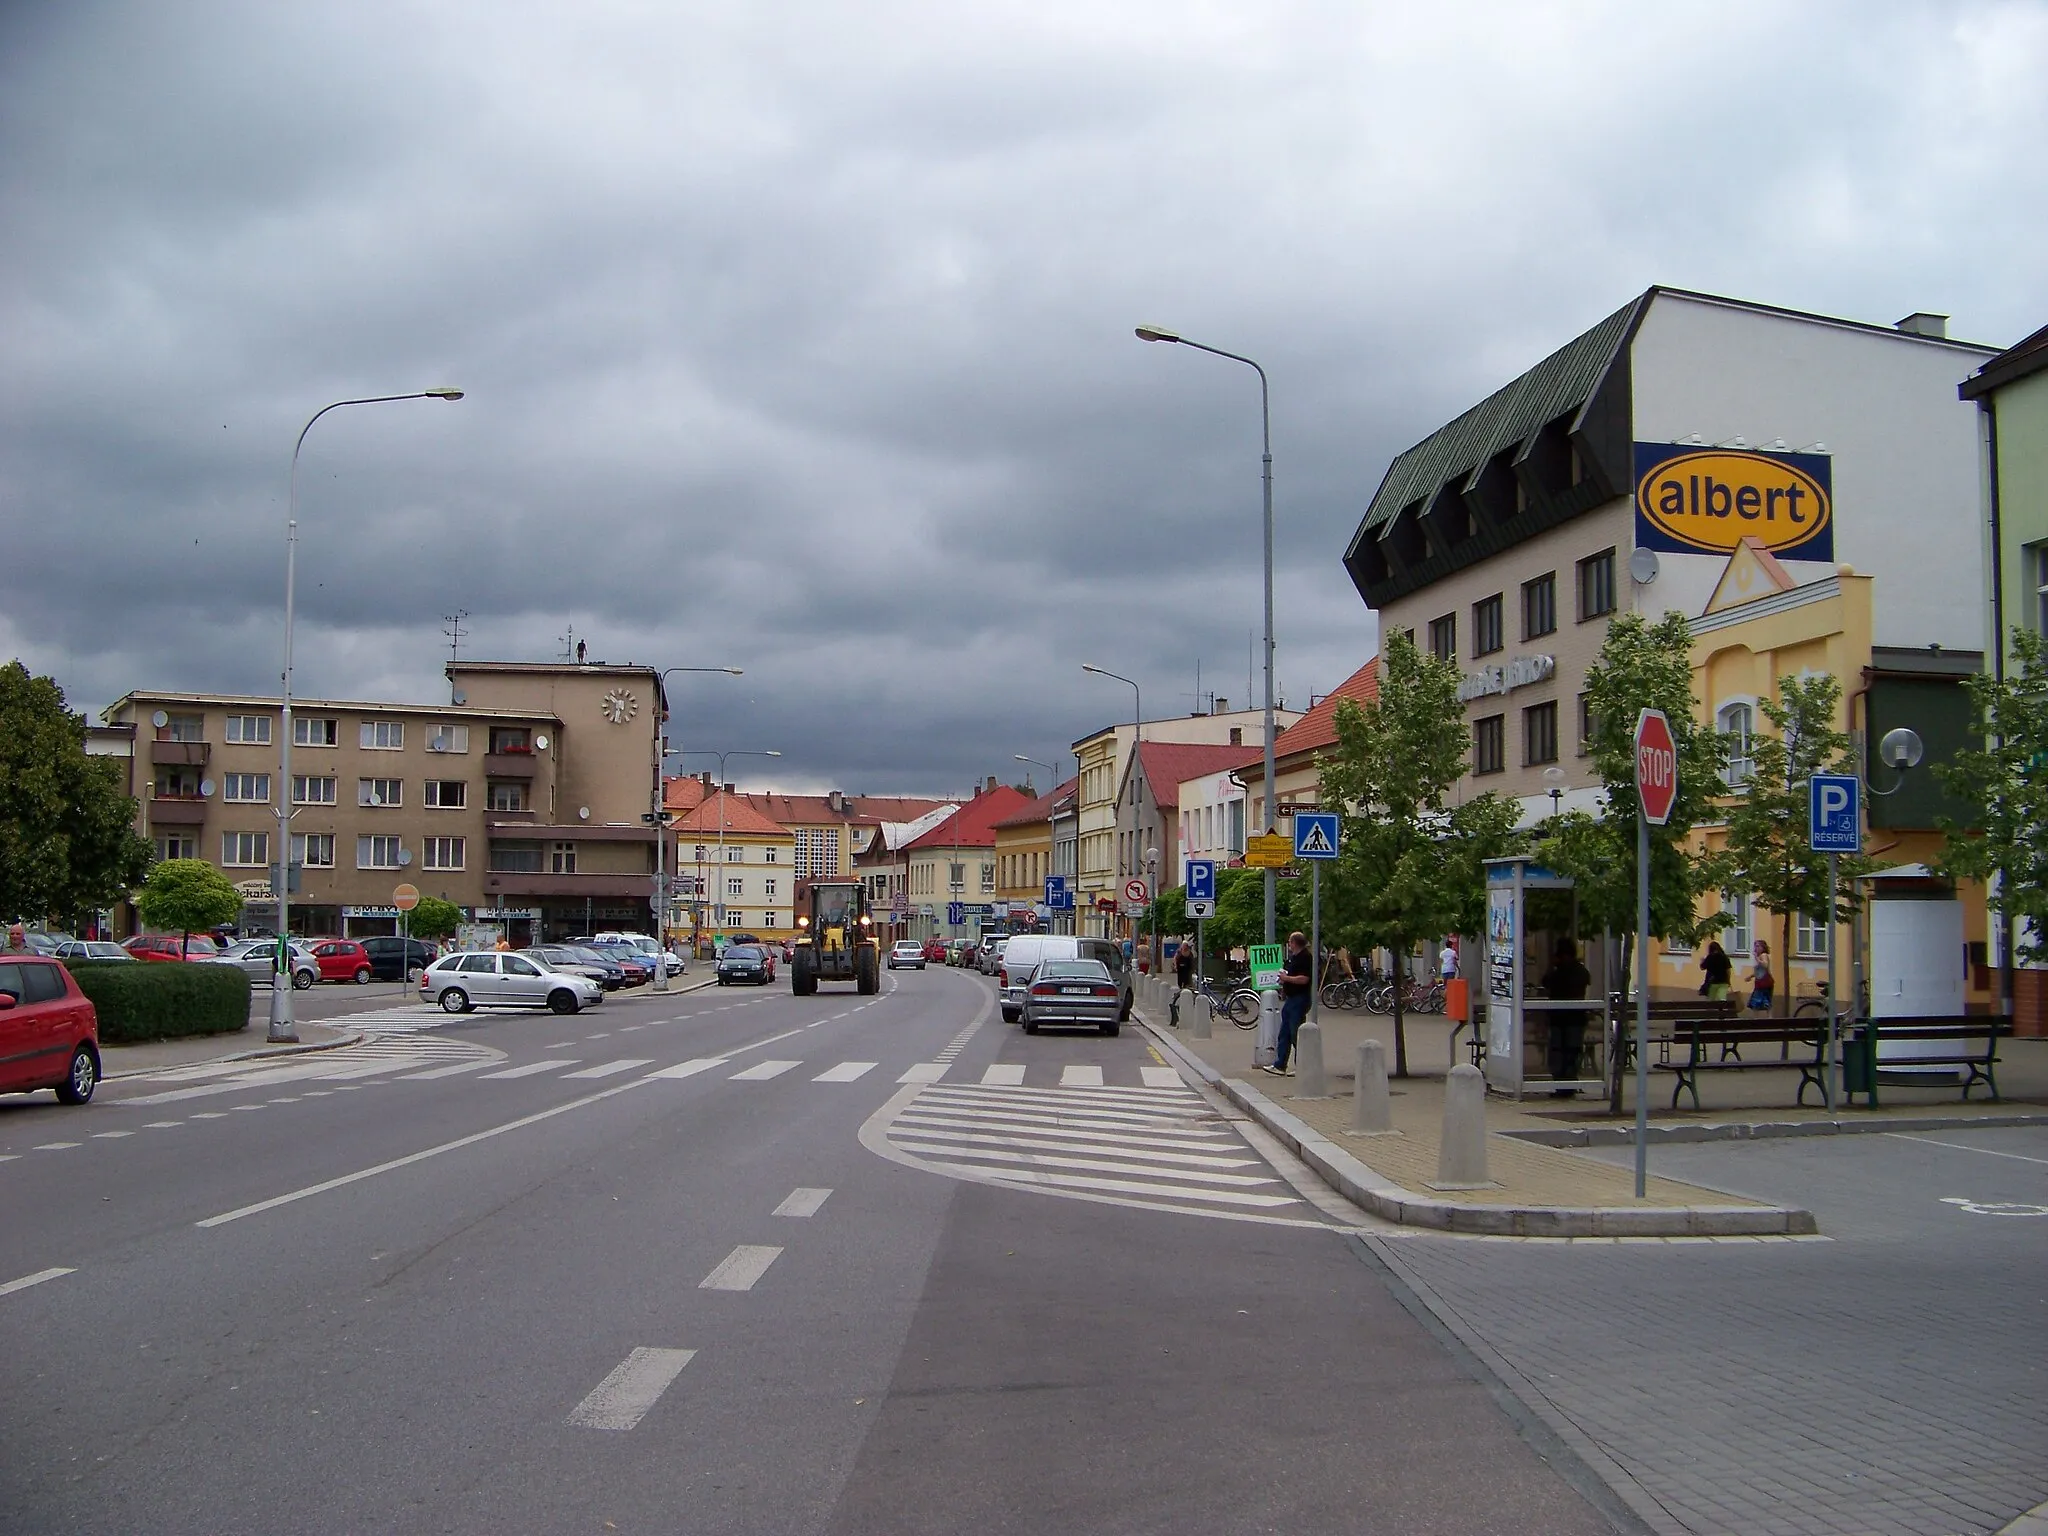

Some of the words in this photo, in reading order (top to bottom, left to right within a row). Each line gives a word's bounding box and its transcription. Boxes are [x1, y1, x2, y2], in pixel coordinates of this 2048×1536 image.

[1658, 474, 1806, 523] albert
[1640, 745, 1672, 788] STOP
[1820, 784, 1849, 828] P
[1814, 831, 1856, 843] RÉSERVÉ
[1192, 865, 1209, 887] P
[1252, 947, 1280, 965] TRHY
